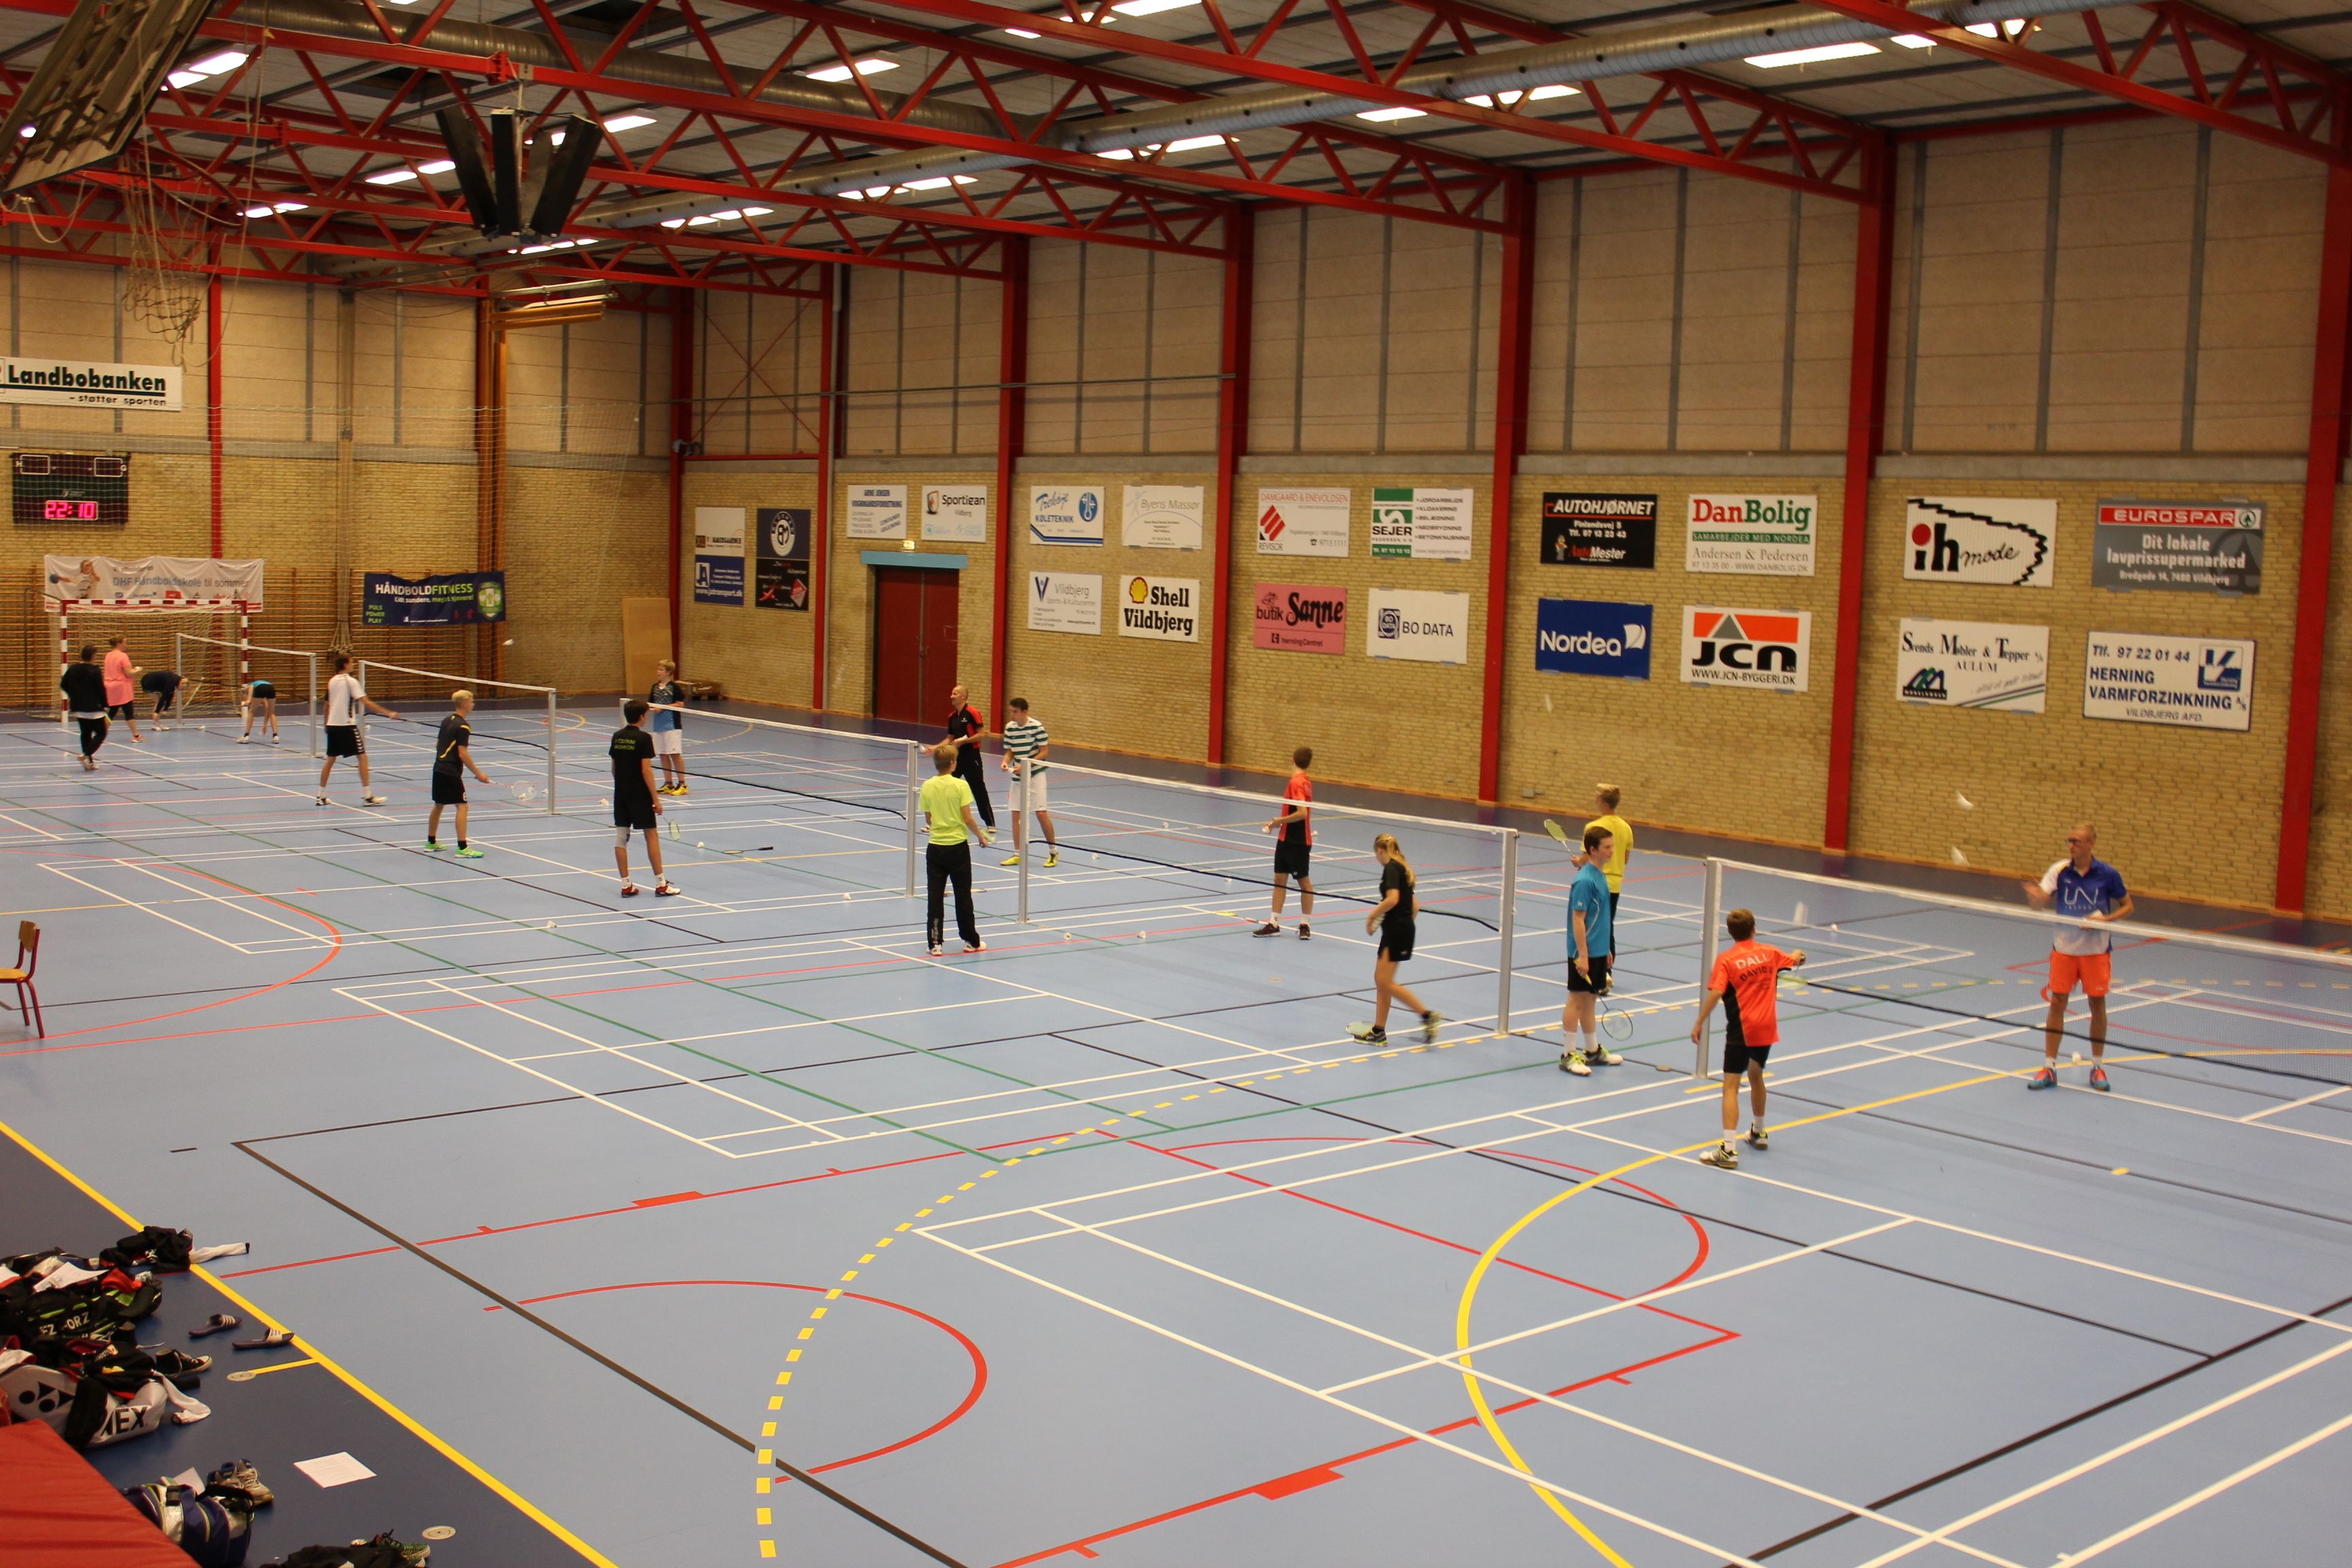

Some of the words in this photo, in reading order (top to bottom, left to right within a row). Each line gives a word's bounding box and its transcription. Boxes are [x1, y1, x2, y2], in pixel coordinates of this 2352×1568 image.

[8, 365, 166, 391] Landbobanken
[78, 395, 116, 404] støtter
[123, 397, 166, 406] sporten
[942, 495, 985, 506] Sportigan
[1141, 499, 1166, 510] Byens
[1261, 493, 1298, 502] DAMGAARD
[1306, 493, 1348, 502] ENEVOLDSEN
[45, 502, 95, 519] 22:10
[1553, 500, 1654, 515] AUTOHJØRNET
[1693, 500, 1812, 531] DanBolig
[2114, 509, 2235, 523] EUROSPAR
[1372, 526, 1412, 536] SEJER
[1693, 533, 1750, 542] SAMARBEJDER
[1752, 534, 1771, 542] MED
[1774, 534, 1810, 543] NORDEA
[2142, 534, 2163, 549] Dit
[2167, 534, 2210, 551] lokale
[1693, 547, 1741, 559] Andersen
[1746, 549, 1755, 560] &
[1760, 549, 1809, 561] Pedersen
[1959, 541, 2020, 568] mode
[2107, 548, 2246, 570] lavprissupermarked
[1151, 586, 1189, 607] Shell
[1256, 606, 1284, 621] butik
[1286, 592, 1344, 628] Sanne
[1124, 608, 1193, 636] Vildbjerg
[1403, 621, 1419, 634] BO
[1423, 623, 1454, 637] DATA
[1541, 630, 1622, 657] Nordea
[1902, 631, 1934, 653] Svends
[1982, 646, 1991, 657] &
[2117, 647, 2132, 659] 97
[2136, 648, 2151, 660] 22
[2155, 649, 2169, 662] 01
[2175, 651, 2191, 662] 44
[1955, 660, 1997, 672] AULUM
[1691, 669, 1796, 685] WWW.JCN-BYGGERI.DK
[2090, 666, 2155, 685] HERNING
[2089, 685, 2232, 710] VARMFORZINKNING
[2126, 708, 2179, 720] VILDBJERG
